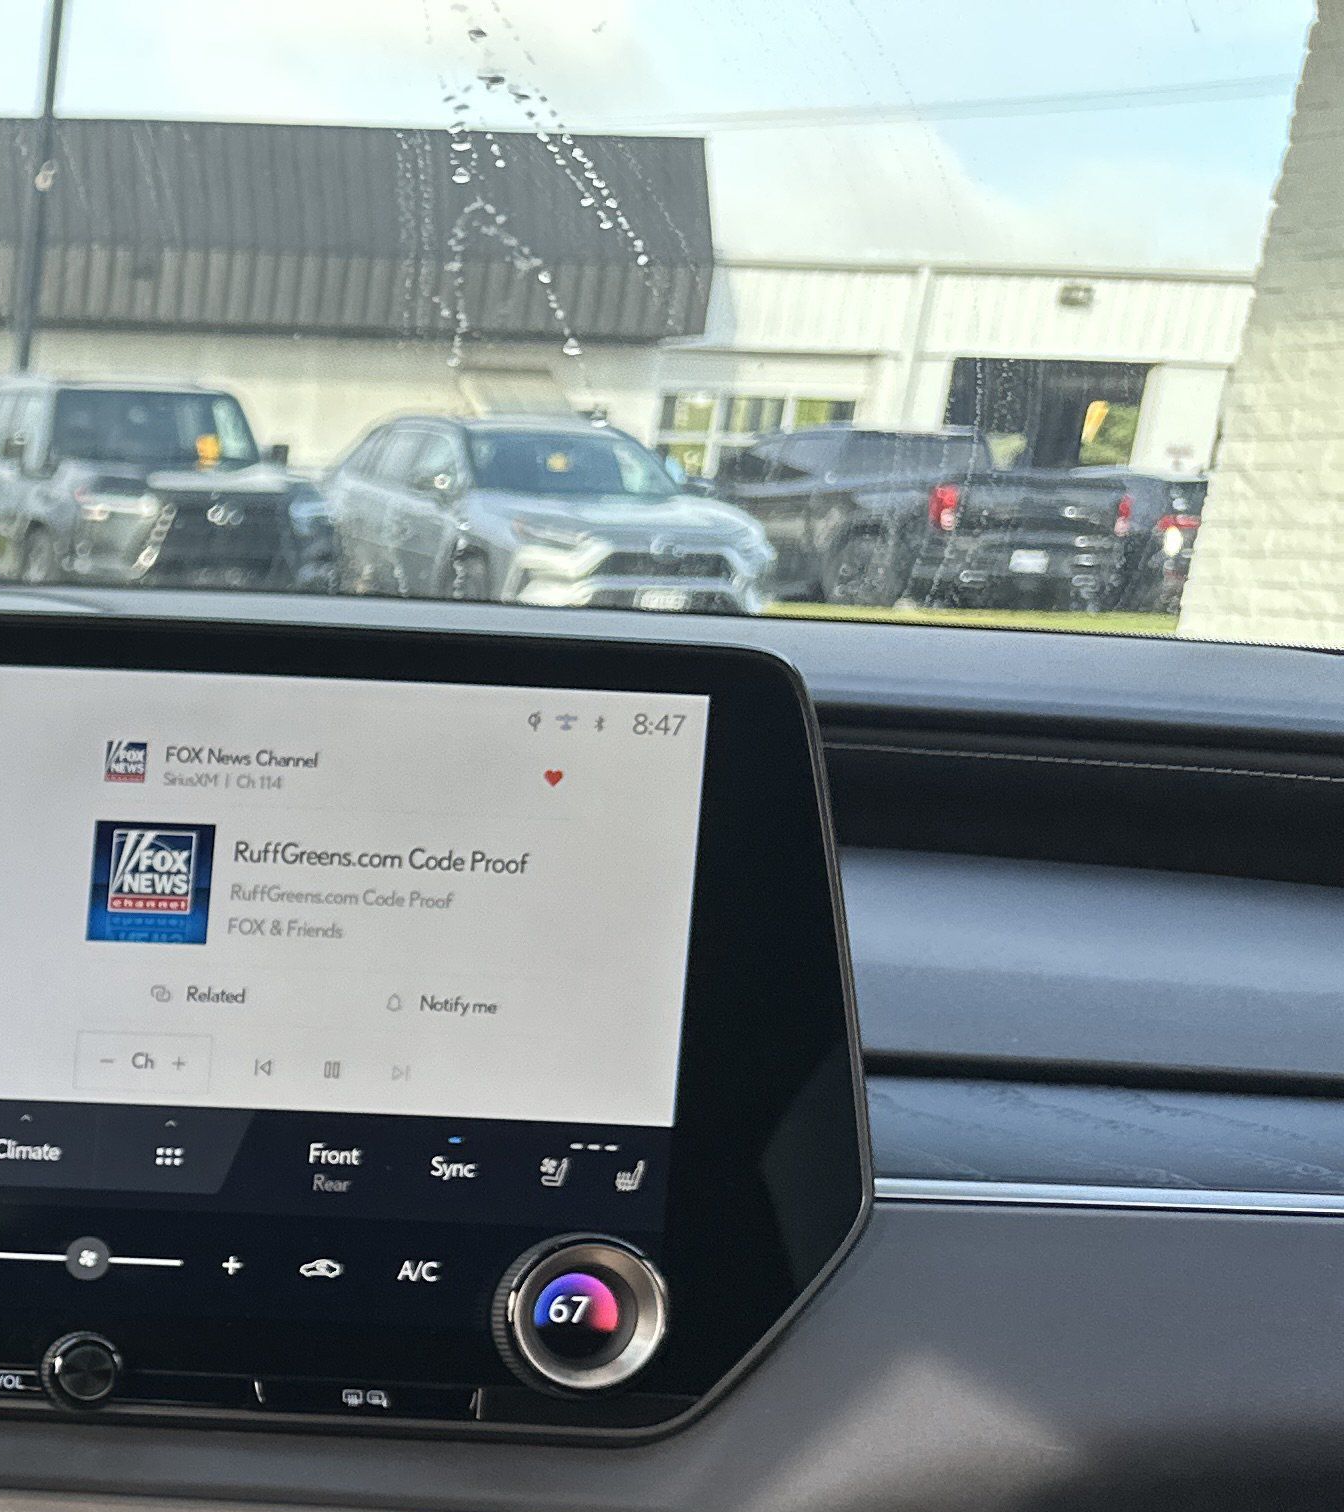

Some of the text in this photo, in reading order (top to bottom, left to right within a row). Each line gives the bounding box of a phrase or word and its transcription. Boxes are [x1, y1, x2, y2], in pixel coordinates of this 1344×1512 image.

[632, 713, 686, 738] 8:47
[165, 746, 319, 768] FOX News Channel
[236, 774, 256, 789] Ch
[138, 849, 190, 872] FOX
[233, 840, 530, 875] RuffGreens.com Code Proof
[121, 872, 189, 894] NEWS
[112, 898, 186, 910] channel
[230, 883, 455, 909] RuffGreens.com Code Proof
[227, 917, 343, 939] FOX & Friends
[186, 985, 246, 1004] Related
[420, 994, 498, 1017] Notify me
[131, 1052, 155, 1071] Ch
[308, 1142, 362, 1166] Front
[430, 1157, 476, 1181] Sync
[312, 1173, 351, 1194] Rear
[397, 1260, 442, 1283] A/C
[549, 1294, 591, 1325] 67
